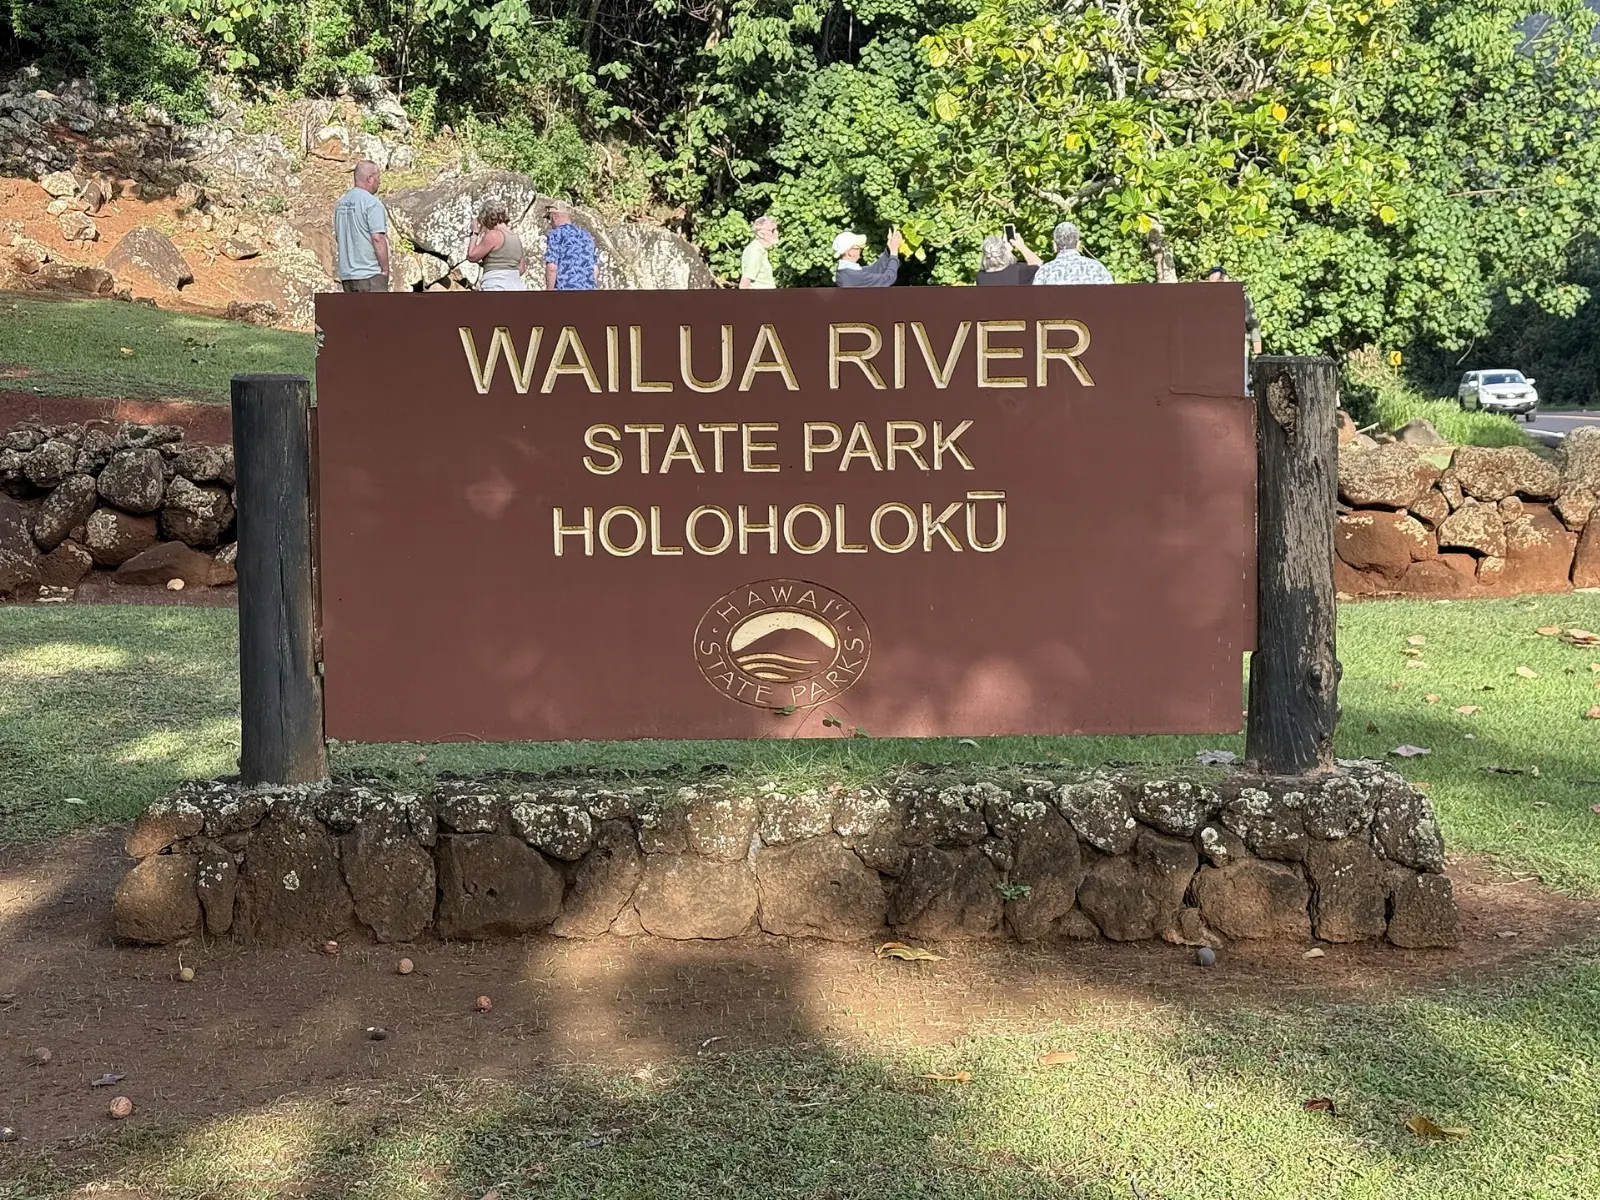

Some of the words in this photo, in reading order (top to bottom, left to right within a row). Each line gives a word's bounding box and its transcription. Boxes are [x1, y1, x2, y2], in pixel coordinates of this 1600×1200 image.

[458, 324, 800, 395] WAILUA
[827, 319, 1096, 390] RIVER
[582, 422, 781, 476] STATE
[803, 419, 977, 472] PARK
[552, 490, 1008, 557] HOLOHOLOKŪ
[700, 640, 774, 704] STATE
[790, 637, 865, 702] PARKS
